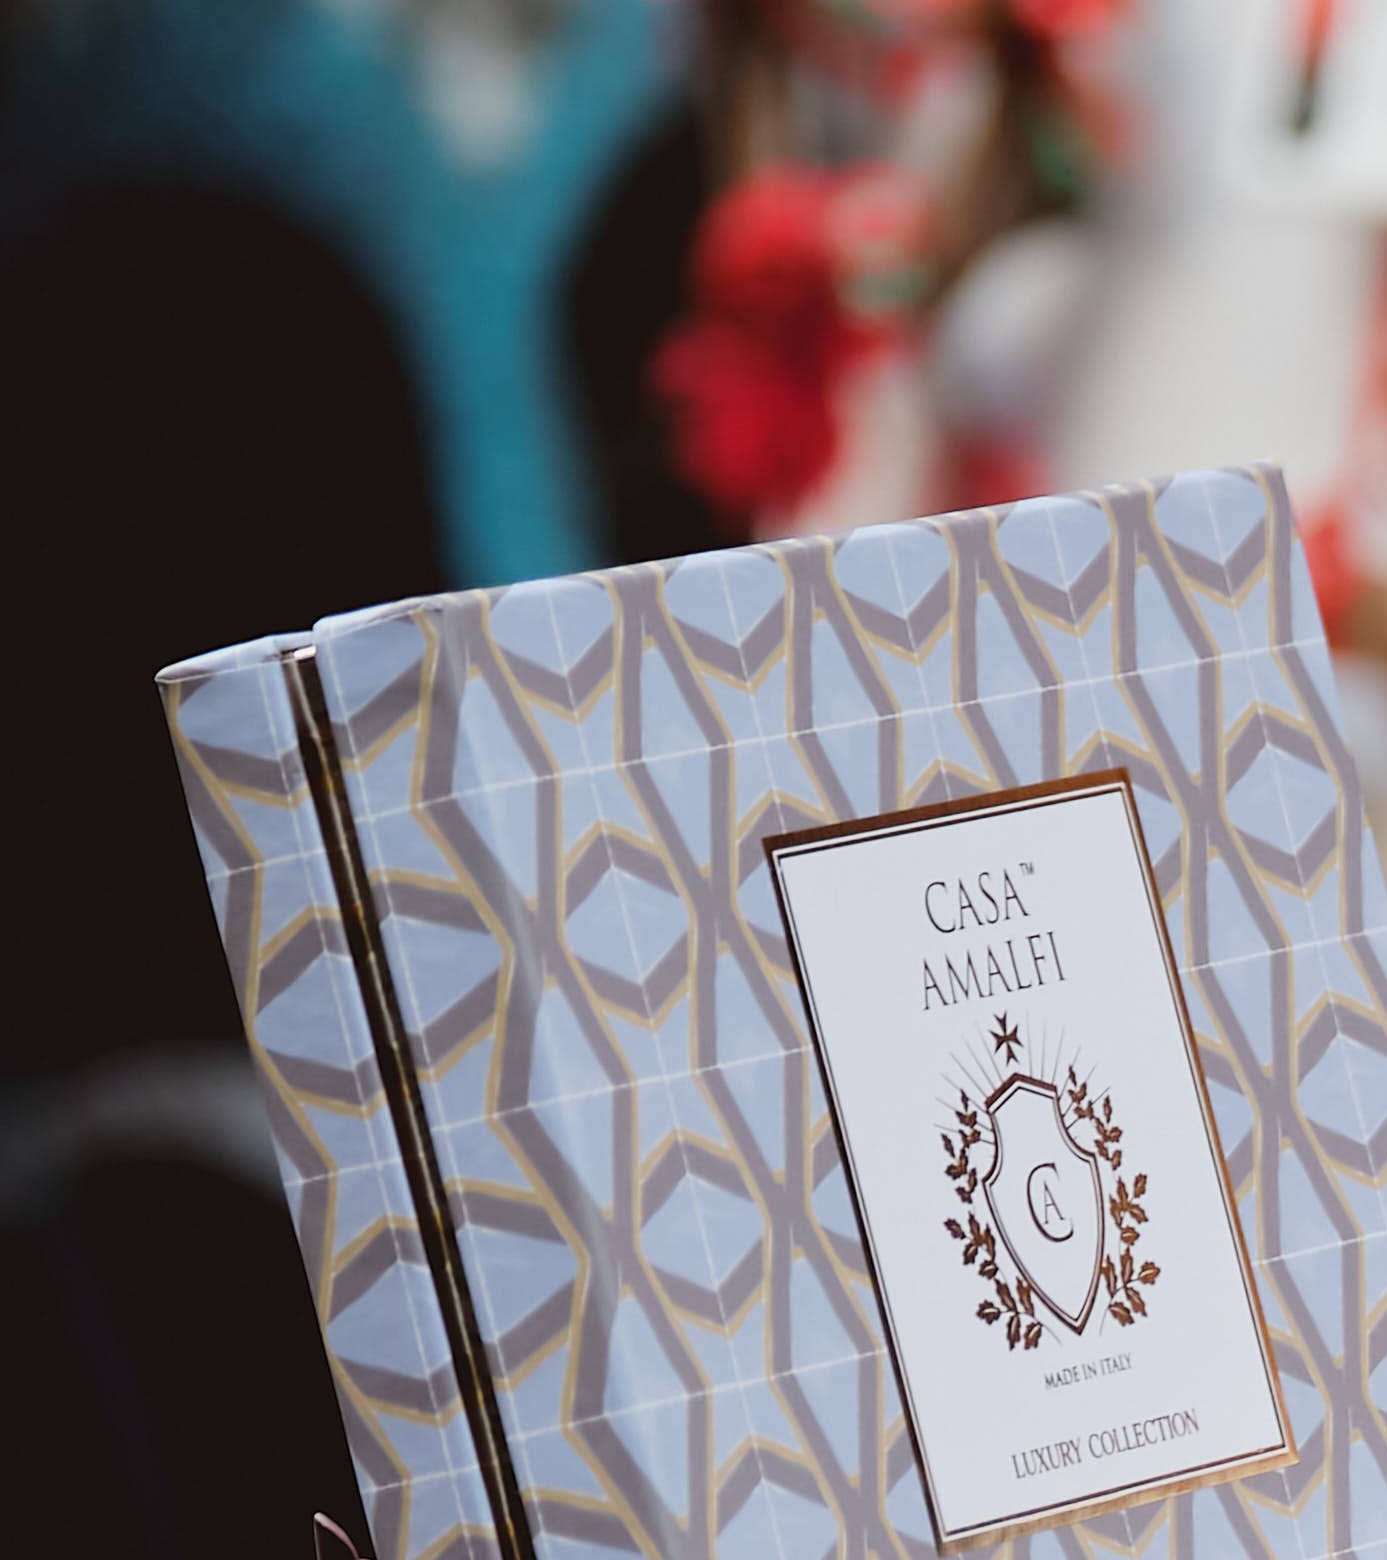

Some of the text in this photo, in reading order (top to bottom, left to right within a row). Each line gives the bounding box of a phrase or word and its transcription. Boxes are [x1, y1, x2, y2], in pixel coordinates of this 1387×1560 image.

[922, 930, 1066, 1011] AMALFI
[1043, 1351, 1134, 1390] MADE IN ITALY
[1011, 1408, 1201, 1480] LUXURY COLLECTION
